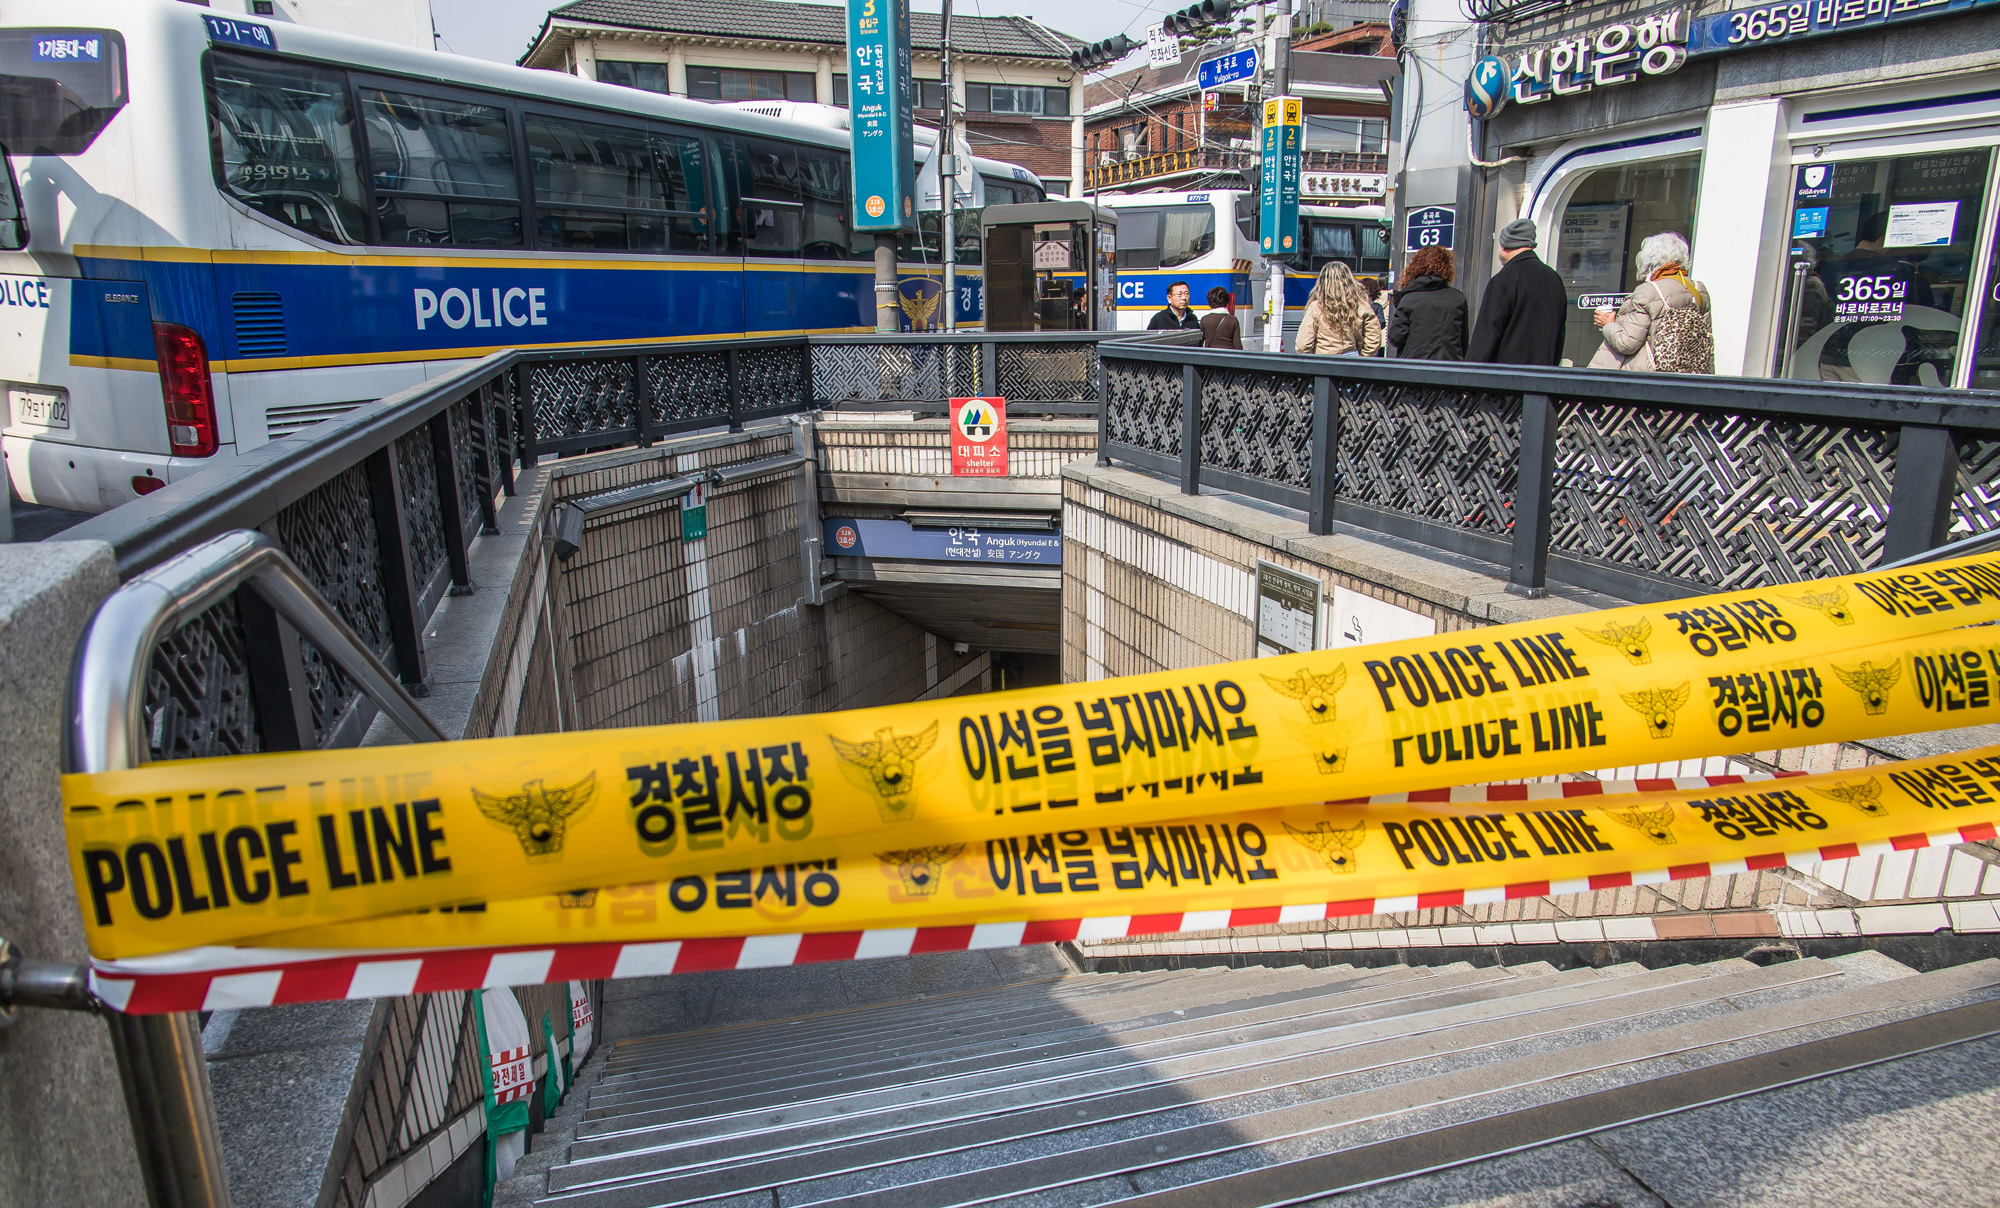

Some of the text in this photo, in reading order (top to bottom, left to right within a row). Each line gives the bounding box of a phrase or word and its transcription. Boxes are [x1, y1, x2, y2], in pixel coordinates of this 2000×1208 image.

[859, 18, 878, 29] 출입구
[1728, 3, 1809, 44] 365일
[38, 40, 98, 59] 1기동대-예
[1512, 10, 1681, 104] 신한은행
[857, 45, 873, 95] 안국
[1216, 56, 1237, 74] 율곡로
[1246, 57, 1254, 69] 65
[1200, 71, 1207, 82] 61
[1214, 71, 1239, 83] Yulgok-ro
[862, 104, 882, 113] Anguk
[1268, 129, 1274, 142] 2
[1288, 127, 1295, 140] 2
[1422, 211, 1440, 220] 율곡로
[1420, 229, 1440, 246] 63
[0, 280, 49, 309] LICE
[1117, 281, 1144, 299] ICE
[1837, 275, 1907, 301] 365일
[105, 293, 139, 304] ELEGANCE
[1590, 296, 1614, 306] 신한은행
[414, 286, 547, 330] POLICE
[1835, 302, 1905, 315] 바로바로코너
[1834, 314, 1902, 323] 운영시간 07:00~23:30
[958, 445, 1001, 458] 대피소
[966, 459, 994, 467] shelter
[838, 536, 854, 545] 3호선
[948, 527, 981, 546] 안국
[986, 536, 1060, 547] Anguk (Hyundai E &
[945, 547, 982, 559] (현대건설)
[1009, 550, 1041, 560] アングク
[1854, 574, 1955, 618] 이선을
[1663, 598, 1797, 658] 경찰서장
[1363, 632, 1590, 713] POLICE LINE
[1914, 651, 1990, 713] 이선을
[1708, 666, 1826, 739] 경찰서장
[958, 680, 1258, 784] 이선을 넘지마시오
[1530, 701, 1607, 754] LINE
[626, 742, 812, 843] 경찰서장
[1888, 764, 1996, 810] 이선을
[1686, 789, 1829, 841] 경찰서장
[1382, 811, 1530, 870] POLICE
[1516, 808, 1614, 857] LINE
[82, 798, 452, 927] POLICE LINE
[986, 827, 1100, 896] 이선을
[1100, 822, 1279, 890] 넘지마시오
